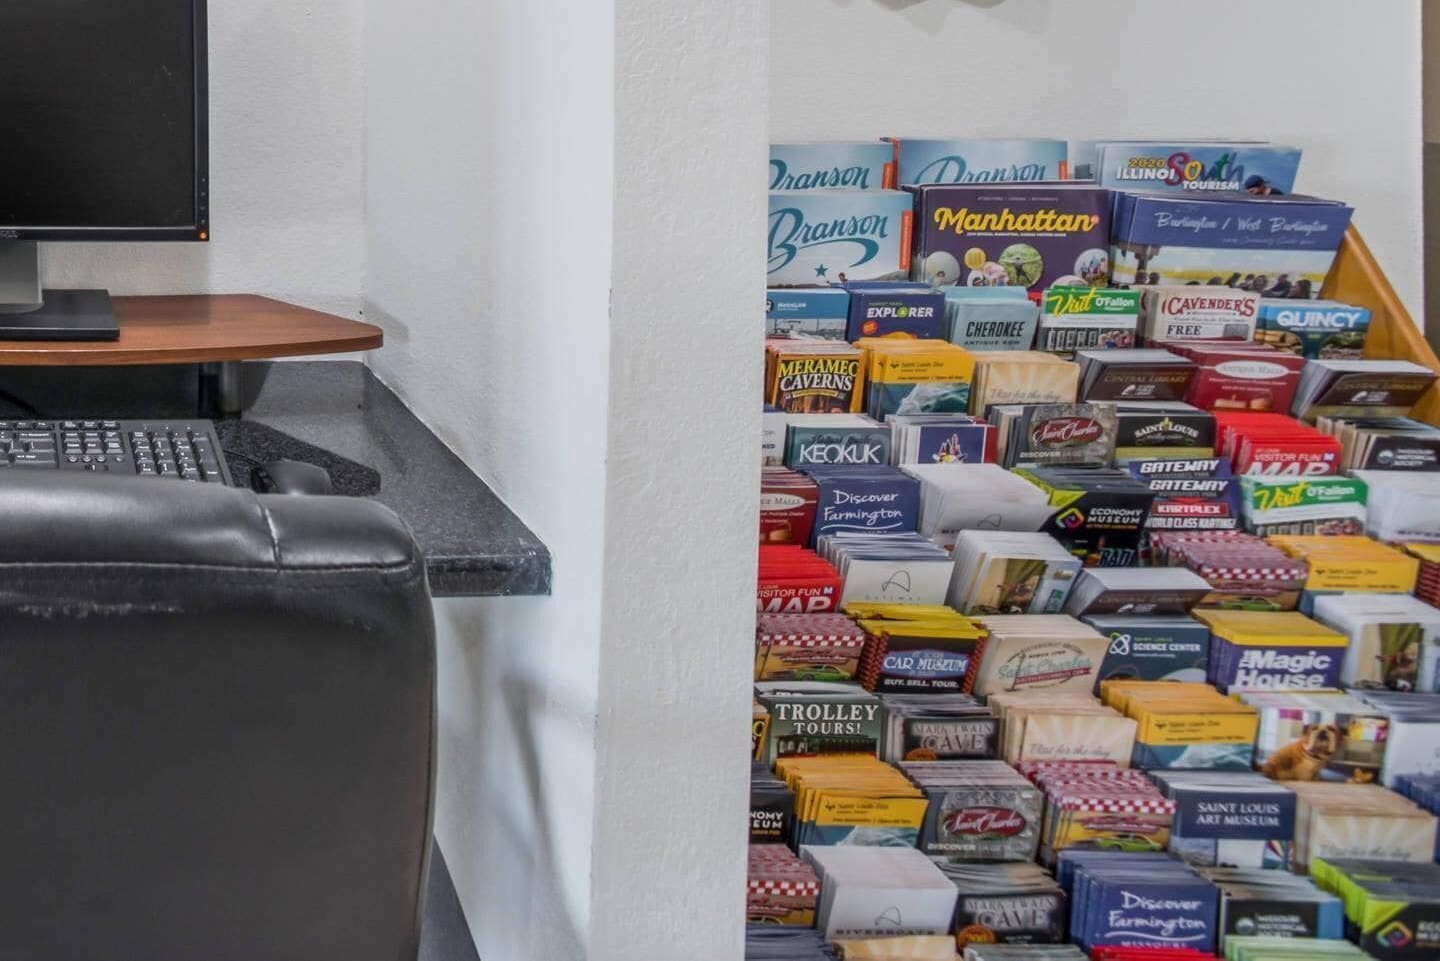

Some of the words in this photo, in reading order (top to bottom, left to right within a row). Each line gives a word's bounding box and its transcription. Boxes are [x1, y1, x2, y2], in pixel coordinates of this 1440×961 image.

[1128, 158, 1166, 168] 2020
[1182, 180, 1240, 190] TOURISM
[934, 207, 1097, 235] Manhattan
[1154, 212, 1217, 233] Burlington
[1237, 217, 1262, 231] West
[1268, 217, 1328, 236] Burlington
[767, 207, 889, 275] Branson
[1046, 287, 1099, 318] Visit
[1095, 297, 1135, 307] O'Fallon
[1167, 297, 1256, 317] CAVENDER'S
[867, 307, 934, 319] EXPLORER
[1276, 310, 1361, 328] QUINCY
[966, 321, 1026, 337] CHEROKEE
[1167, 324, 1202, 336] FREE
[779, 358, 859, 378] MERAMEC
[780, 373, 853, 391] CAVERNS
[1134, 422, 1163, 438] SAINT
[1168, 422, 1199, 438] LOUIS
[798, 443, 882, 464] KEOKUK
[1255, 453, 1298, 462] VISITOR
[1298, 453, 1322, 462] FUN
[1140, 460, 1220, 473] GATEWAY
[1149, 480, 1228, 491] GATEWAY
[833, 490, 899, 505] Discover
[1253, 480, 1311, 511] Visit
[824, 506, 902, 526] Farmington
[1089, 507, 1143, 517] ECONOMY
[1157, 504, 1221, 514] KARTPLEX
[1087, 516, 1140, 524] MUSEUM
[1143, 517, 1172, 528] WORLD
[1173, 518, 1198, 528] CLASS
[798, 587, 821, 597] FUN
[757, 597, 831, 613] MAP
[1133, 643, 1167, 651] SCIENCE
[1168, 643, 1201, 651] CENTER
[883, 657, 914, 670] CAR
[916, 657, 969, 672] MUSEUM
[1250, 650, 1331, 673] Magic
[883, 678, 905, 686] BUY.
[907, 679, 930, 687] SELL.
[931, 680, 959, 688] TOUR.
[1234, 669, 1325, 687] House
[775, 703, 879, 721] TROLLEY
[793, 722, 861, 735] TOURS!
[921, 731, 985, 752] CAVE
[1197, 802, 1236, 814] SAINT
[1240, 803, 1280, 814] LOUIS
[977, 808, 1022, 833] Charles
[1195, 813, 1220, 825] ART
[1223, 814, 1279, 826] MUSEUM
[927, 843, 977, 851] DISCOVER
[1120, 890, 1203, 910] Discover
[976, 908, 1046, 929] CAVE
[1108, 910, 1207, 936] Farmington
